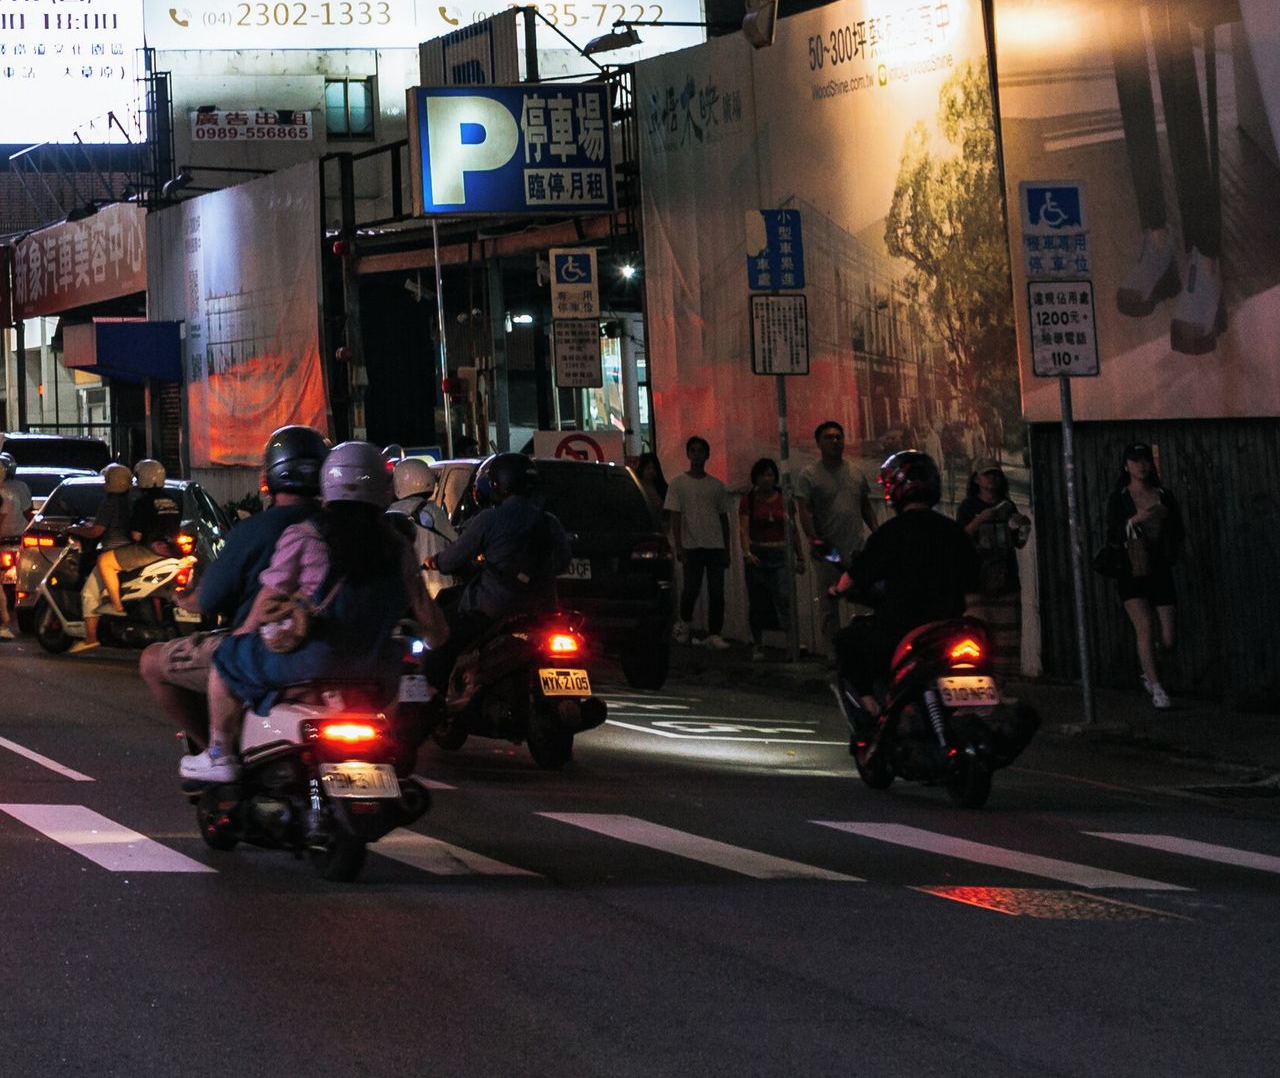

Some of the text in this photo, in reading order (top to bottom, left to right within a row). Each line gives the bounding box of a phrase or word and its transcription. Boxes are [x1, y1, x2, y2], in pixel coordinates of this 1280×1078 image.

[202, 2, 391, 27] (04) 2302-1333
[195, 127, 309, 140] 0989-556865
[426, 96, 519, 205] P
[521, 92, 606, 164] 停車場
[14, 215, 143, 305] 新象汽車美容中心
